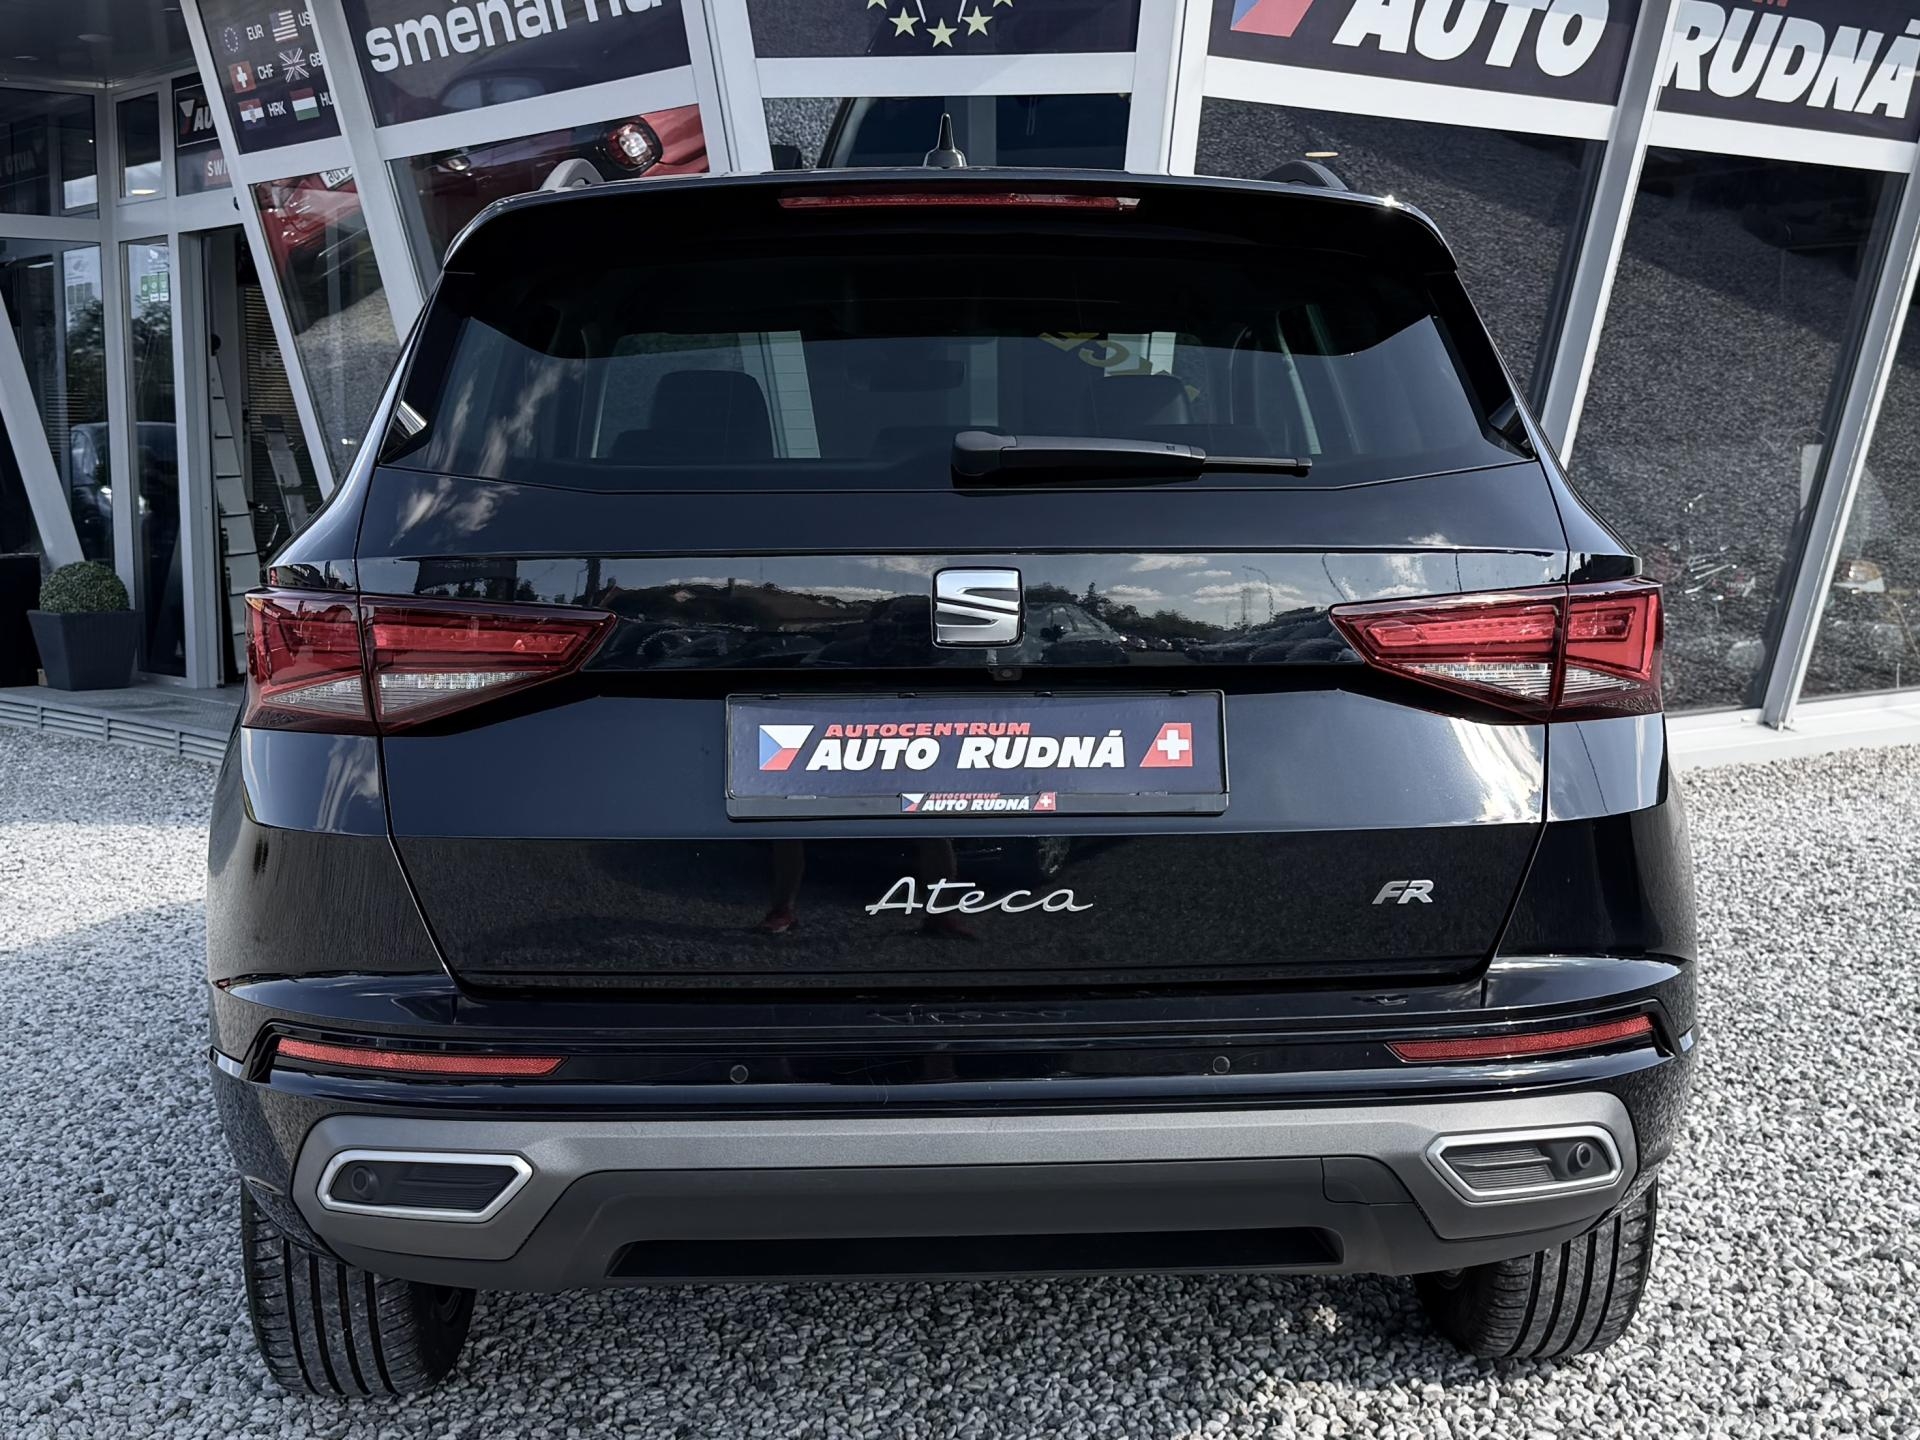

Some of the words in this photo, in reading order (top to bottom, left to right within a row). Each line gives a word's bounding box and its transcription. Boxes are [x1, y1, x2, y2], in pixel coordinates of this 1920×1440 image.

[246, 24, 265, 41] EUR
[1332, 0, 1610, 77] AUTO
[1660, 0, 1920, 119] RUDNÁ
[257, 64, 274, 80] CHF
[267, 101, 287, 117] HRK
[825, 722, 1031, 738] AUTOCENTRUM
[805, 736, 940, 771] AUTO
[956, 729, 1125, 769] RUDNÁ
[921, 799, 969, 811] AUTO
[970, 796, 1030, 811] RUDNÁ
[865, 876, 1094, 915] Ateca
[1371, 879, 1434, 905] FR
